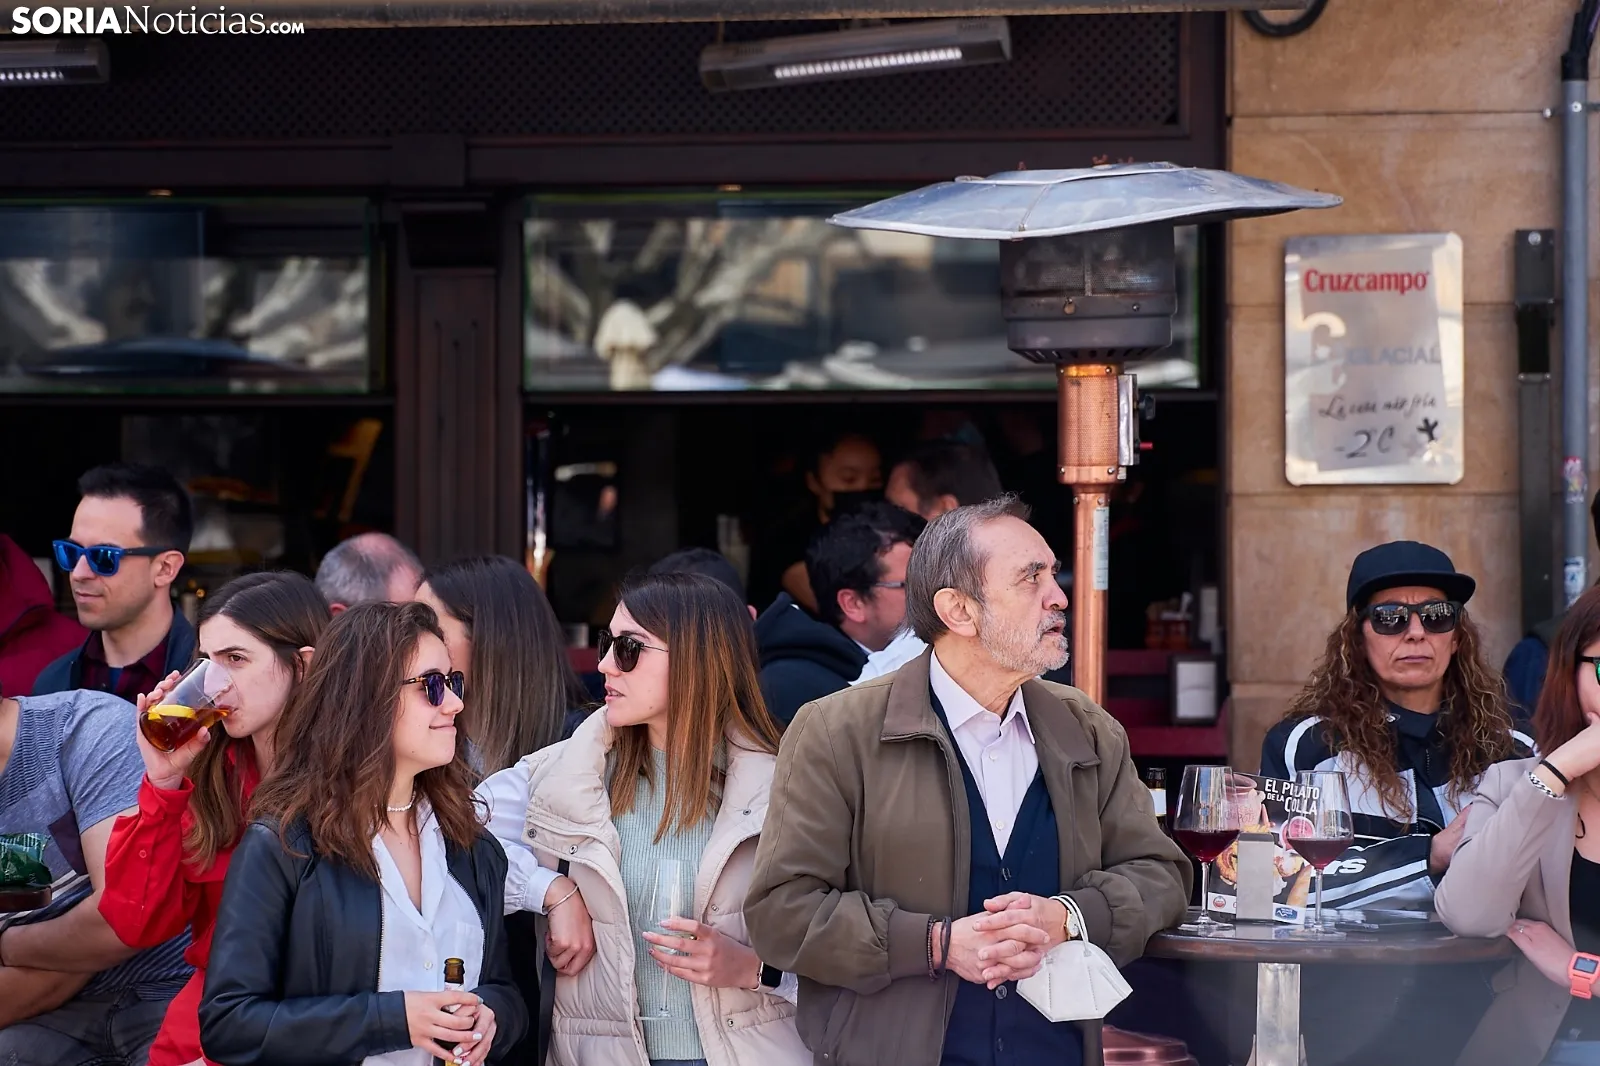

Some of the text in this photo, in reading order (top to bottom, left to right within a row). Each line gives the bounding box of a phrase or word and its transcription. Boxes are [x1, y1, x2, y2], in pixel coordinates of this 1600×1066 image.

[1304, 267, 1428, 295] Cruzcampo
[1264, 778, 1279, 793] EL
[1267, 792, 1276, 801] DE
[1276, 793, 1285, 802] LA
